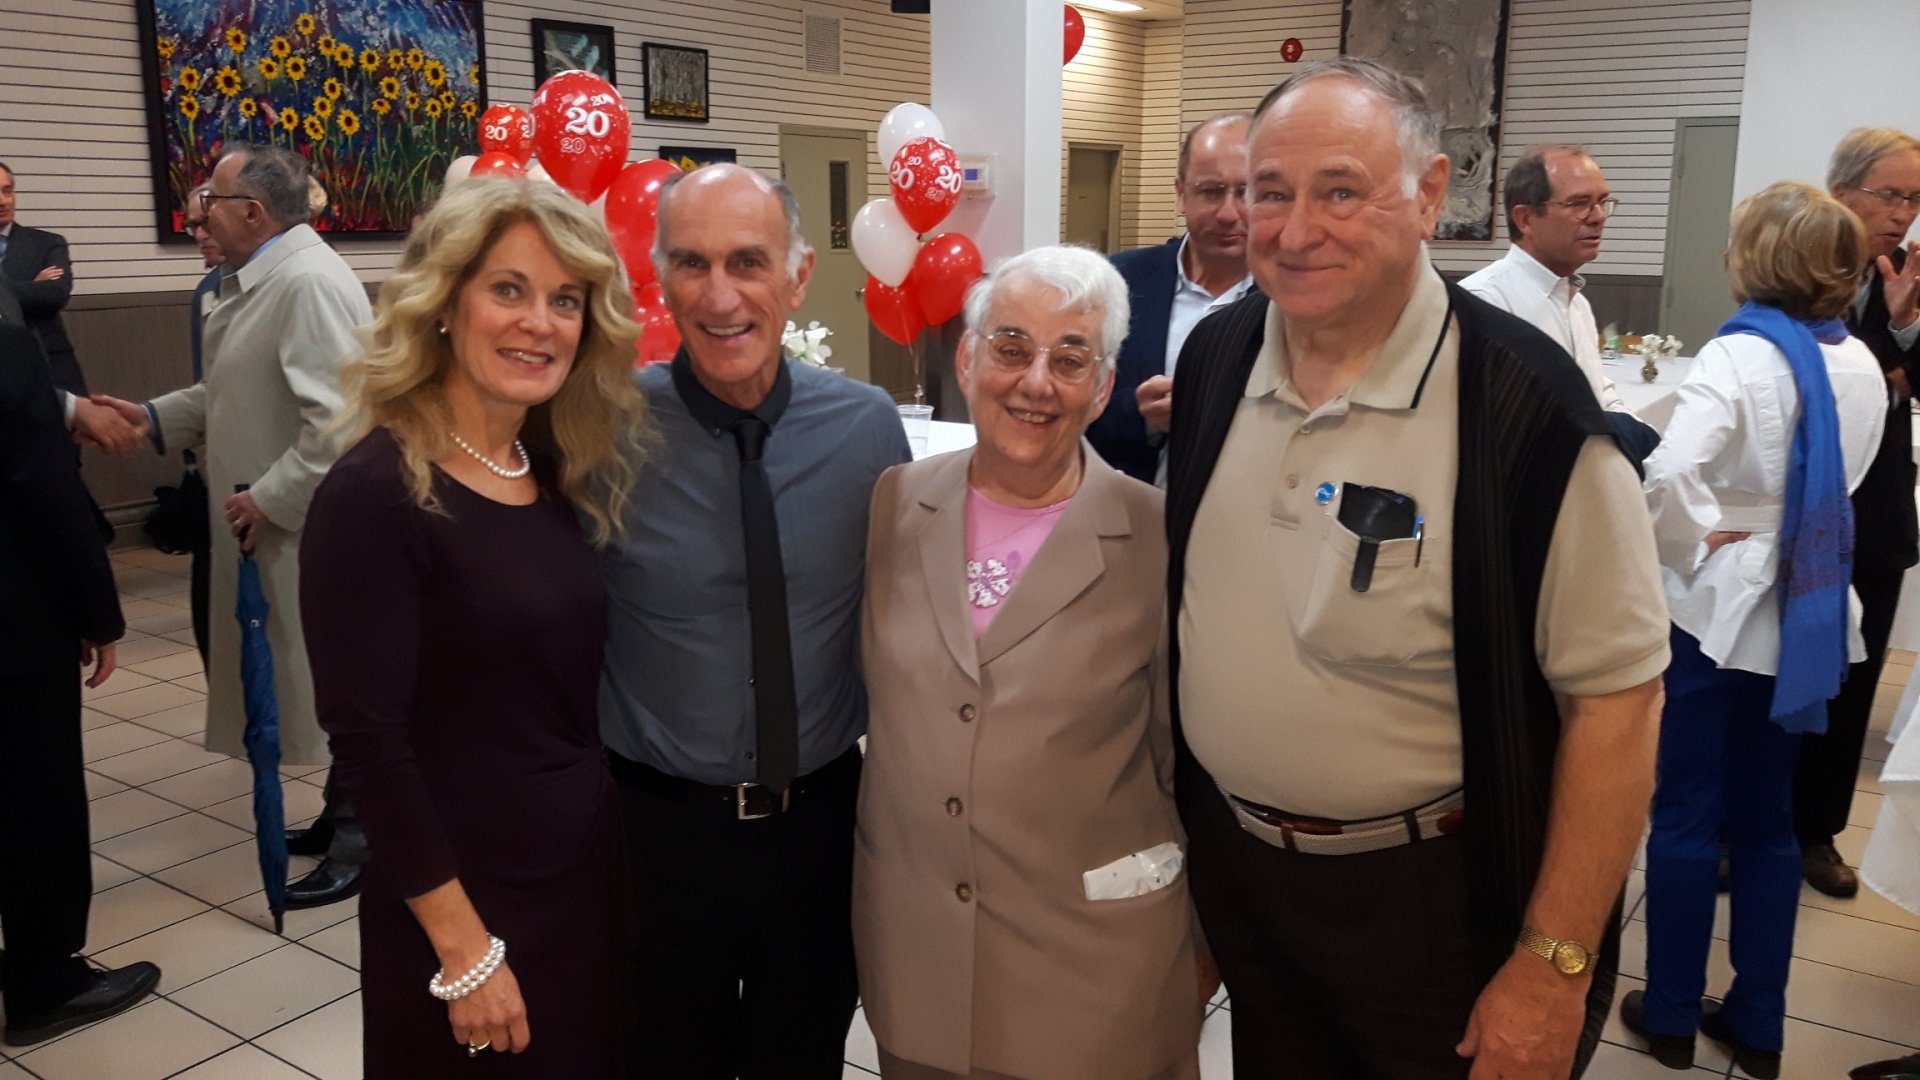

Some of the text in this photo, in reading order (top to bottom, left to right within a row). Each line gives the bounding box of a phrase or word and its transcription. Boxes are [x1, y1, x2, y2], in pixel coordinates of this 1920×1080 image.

[565, 107, 610, 138] 20
[484, 124, 508, 141] 20
[561, 137, 586, 154] 20
[907, 156, 922, 166] 20
[890, 161, 915, 190] 20
[935, 165, 962, 195] 20
[925, 186, 946, 203] 20
